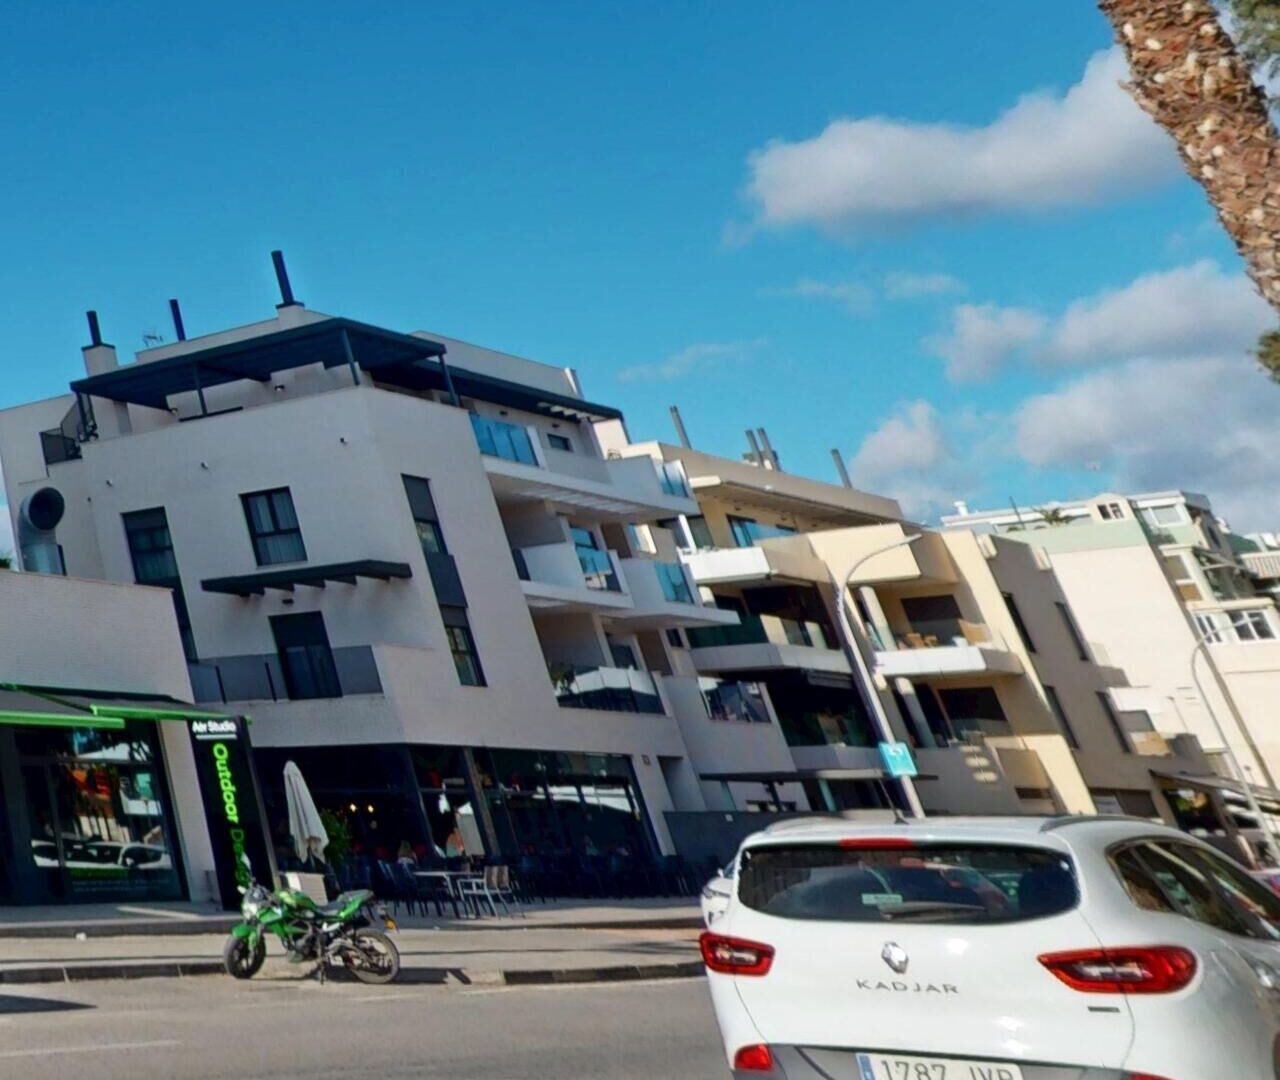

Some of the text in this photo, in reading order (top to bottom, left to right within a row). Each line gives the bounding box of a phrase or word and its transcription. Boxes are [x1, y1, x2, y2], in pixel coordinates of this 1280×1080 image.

[207, 720, 237, 733] Studio
[213, 743, 239, 823] Outdoor
[856, 979, 959, 994] KADJAR
[881, 1060, 947, 1080] 1787
